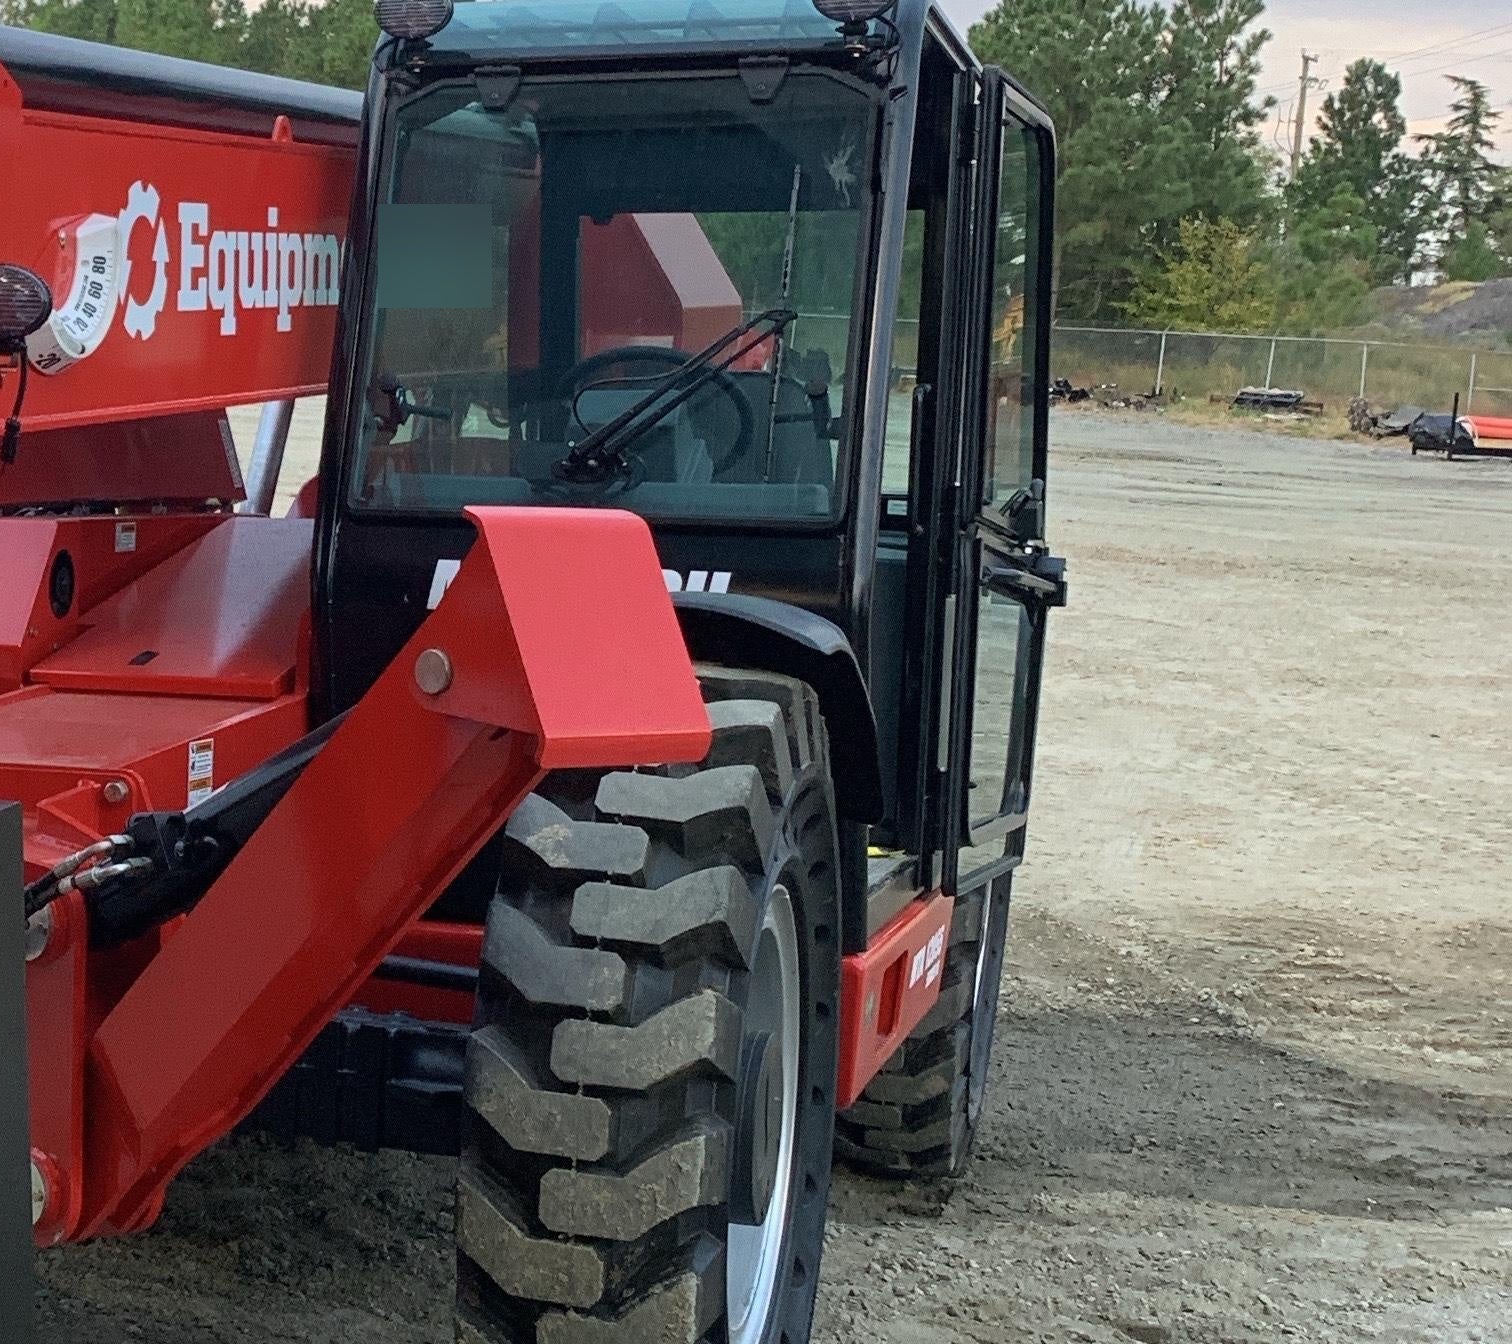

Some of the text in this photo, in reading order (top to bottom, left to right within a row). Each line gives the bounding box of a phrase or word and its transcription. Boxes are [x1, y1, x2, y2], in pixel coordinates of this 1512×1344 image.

[92, 256, 106, 275] 80
[177, 202, 346, 337] Equipm
[88, 281, 103, 299] 60
[81, 302, 96, 318] 40
